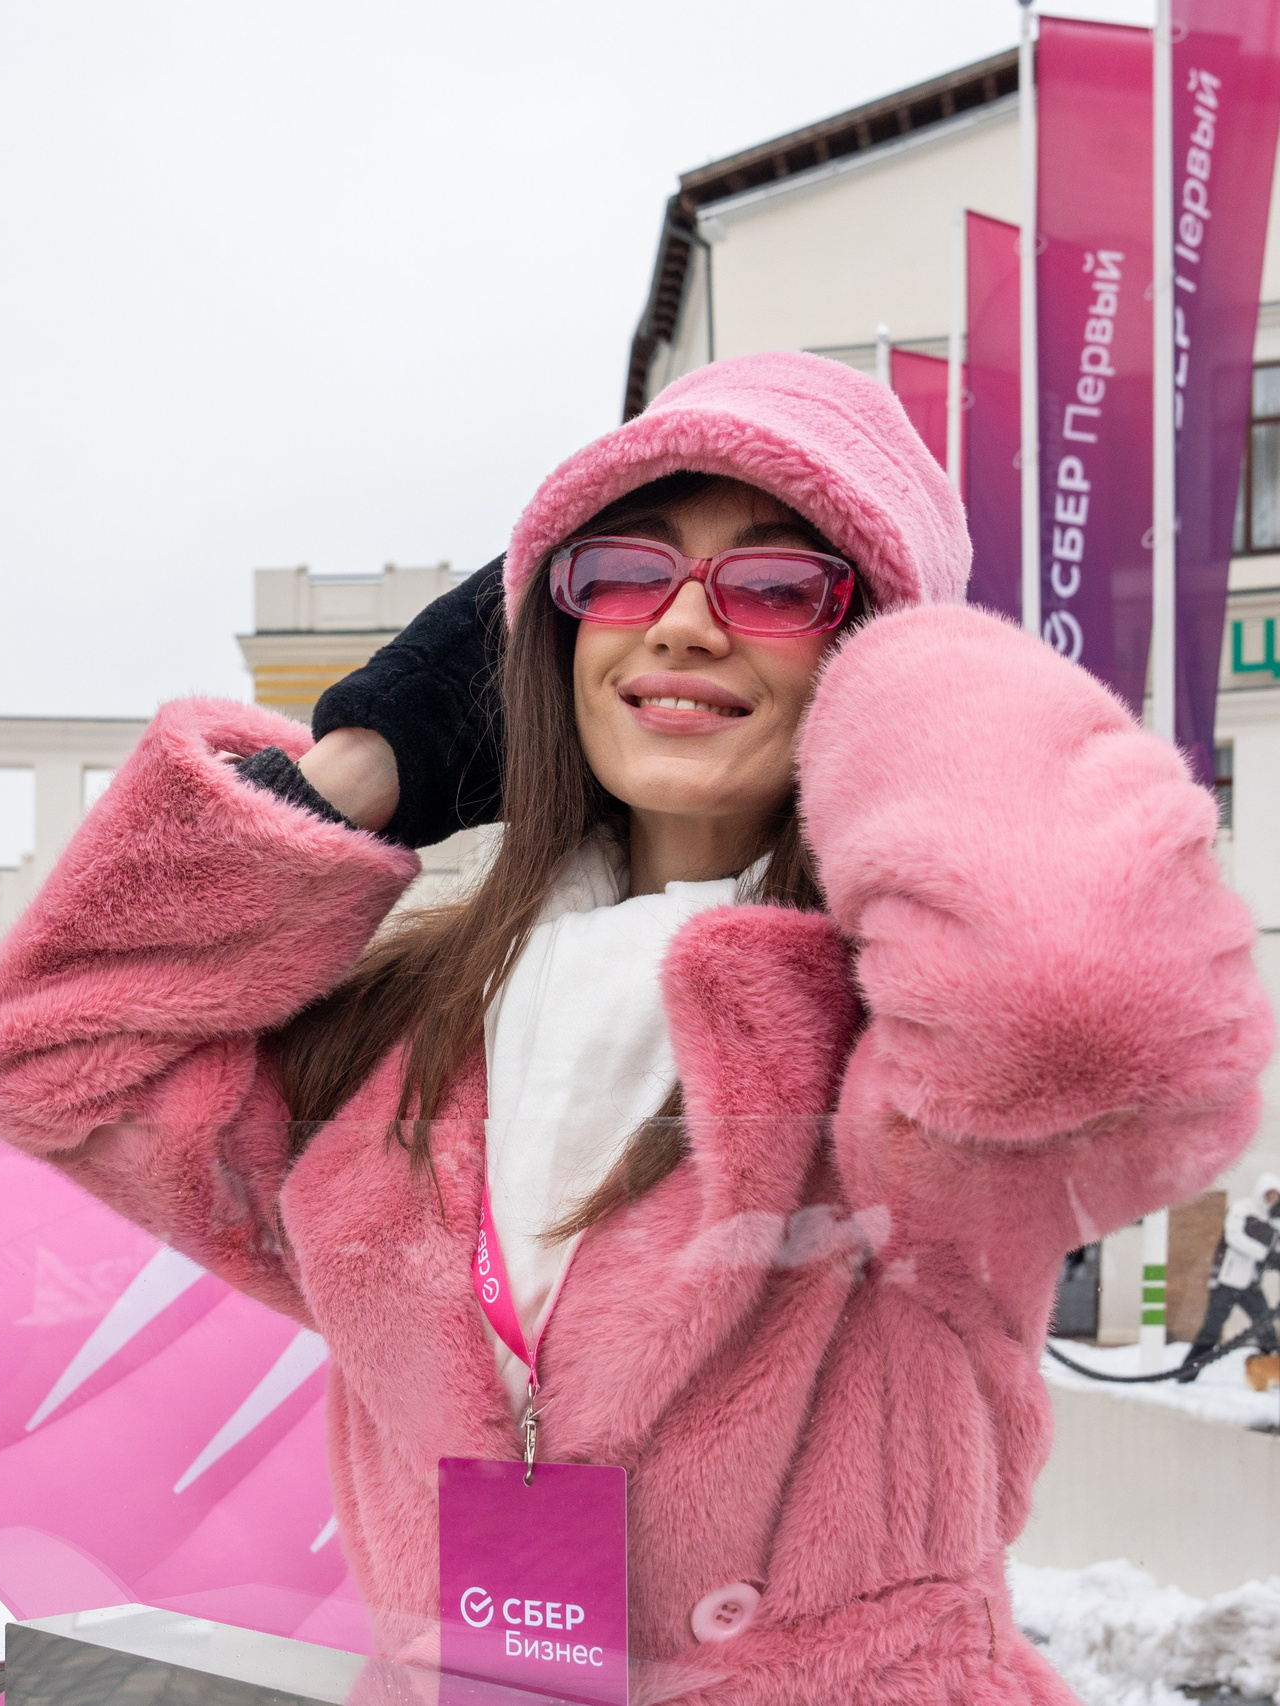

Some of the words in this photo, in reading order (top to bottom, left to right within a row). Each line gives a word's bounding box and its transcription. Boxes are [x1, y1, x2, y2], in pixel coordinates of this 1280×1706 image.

[1063, 249, 1125, 444] Первый
[1051, 455, 1092, 599] СБЕР
[502, 1597, 585, 1631] СБЕР
[505, 1629, 604, 1667] Бизнес
